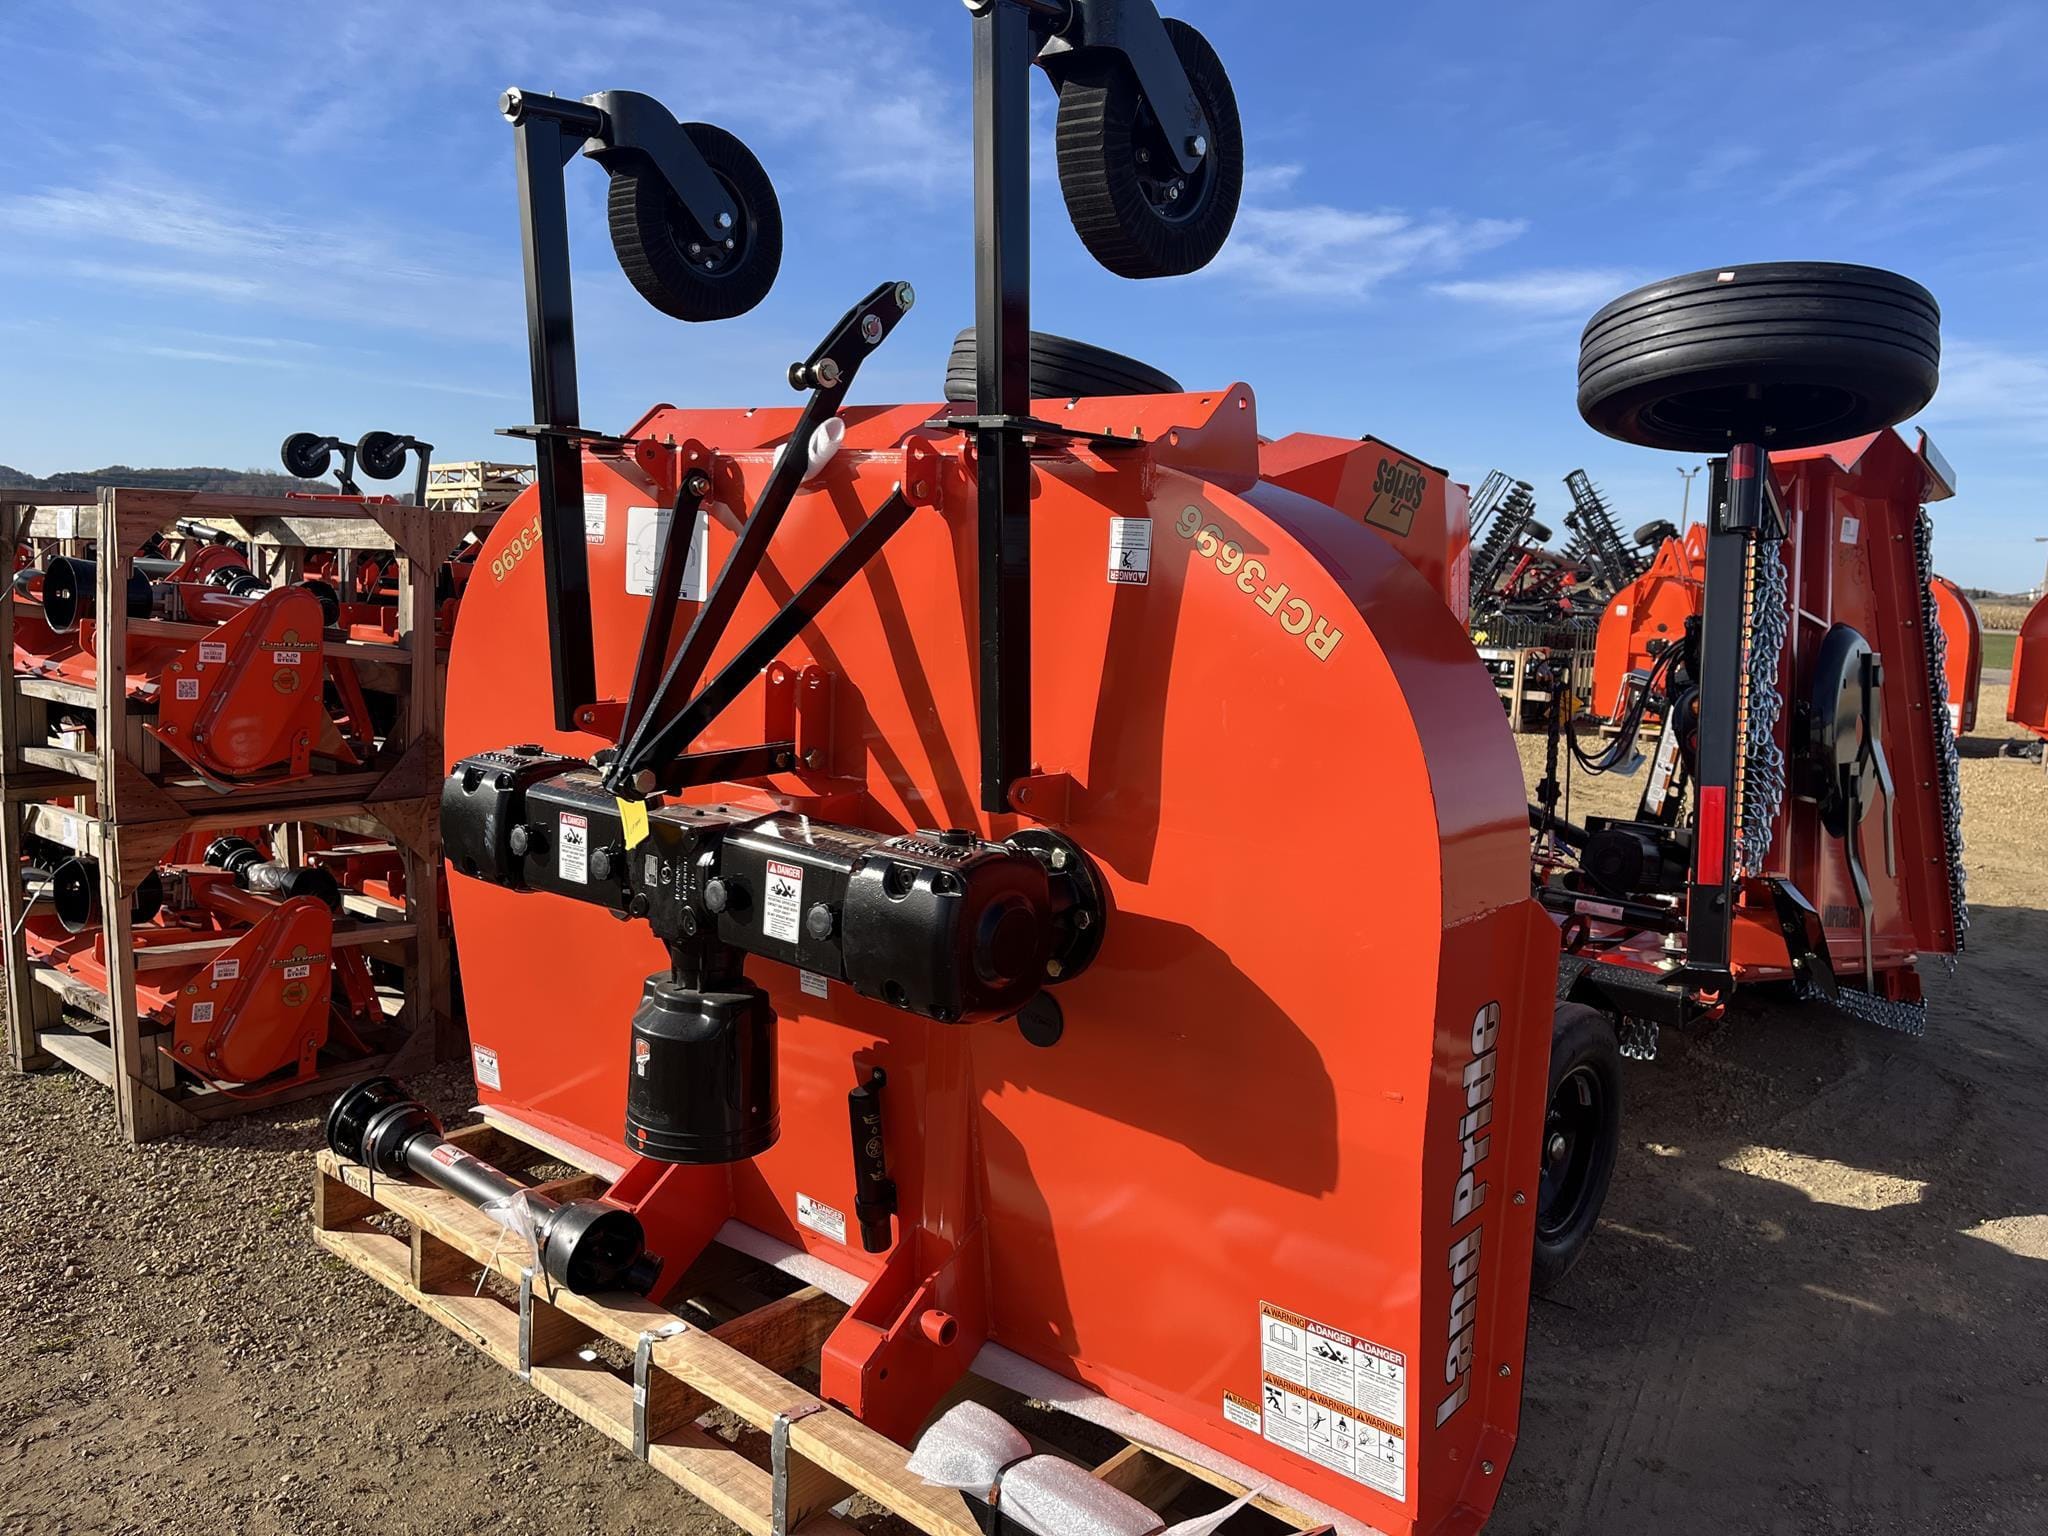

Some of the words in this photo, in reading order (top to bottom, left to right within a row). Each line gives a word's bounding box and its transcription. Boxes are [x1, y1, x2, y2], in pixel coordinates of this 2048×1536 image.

[491, 514, 543, 582] F3696
[1110, 570, 1138, 582] DANGER
[1175, 503, 1345, 663] RCF3696
[776, 864, 801, 879] DANGER
[1450, 1000, 1500, 1226] Pride
[1270, 1307, 1305, 1328] WARNING
[1435, 1224, 1484, 1430] Land
[1316, 1324, 1353, 1346] DANGER
[1365, 1344, 1403, 1365] DANGER
[1273, 1377, 1307, 1397] WARNING
[1317, 1396, 1353, 1416] WARNING
[1365, 1416, 1403, 1437] WARNING
